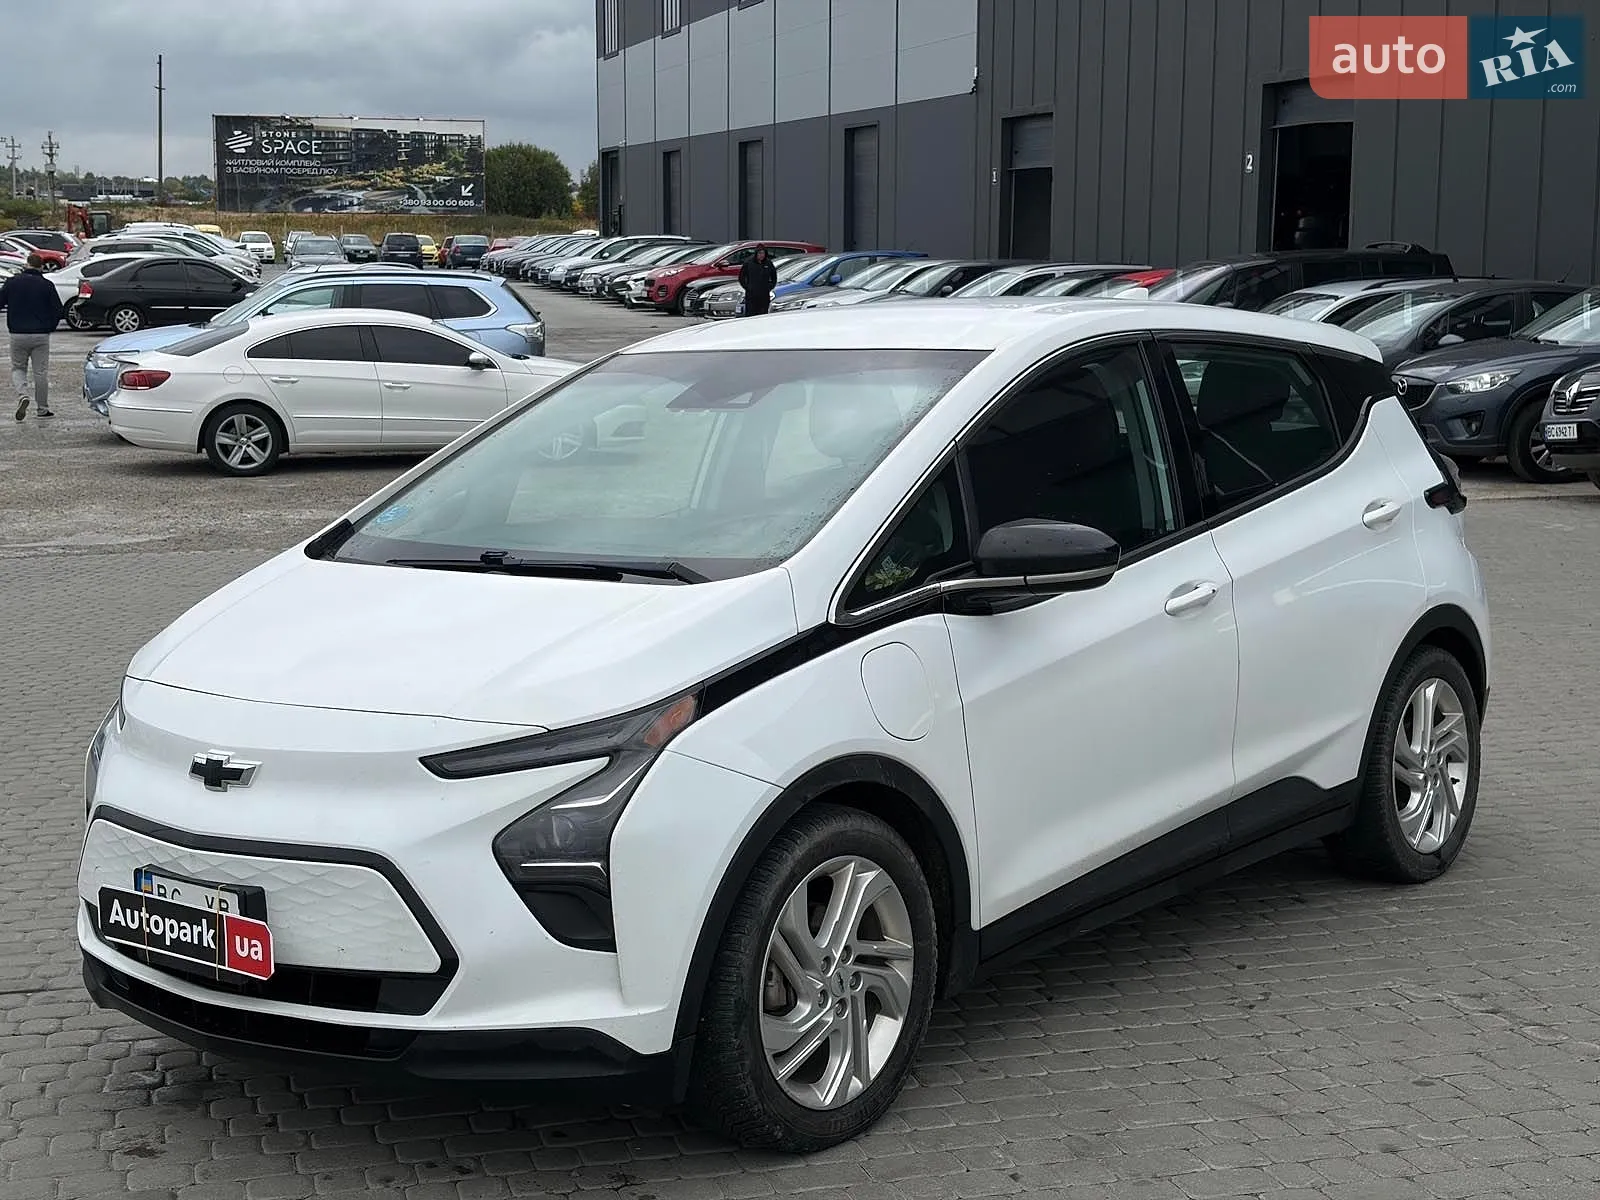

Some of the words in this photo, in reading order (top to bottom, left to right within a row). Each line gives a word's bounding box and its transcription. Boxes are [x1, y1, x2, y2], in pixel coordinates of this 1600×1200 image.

[261, 139, 323, 155] SPACE
[1245, 154, 1253, 170] 2
[233, 166, 279, 174] БАСЕЙНОМ
[280, 167, 319, 175] ПОСЕРЕД
[1568, 425, 1575, 437] TI
[109, 898, 217, 949] Autopark
[235, 935, 263, 961] ua
